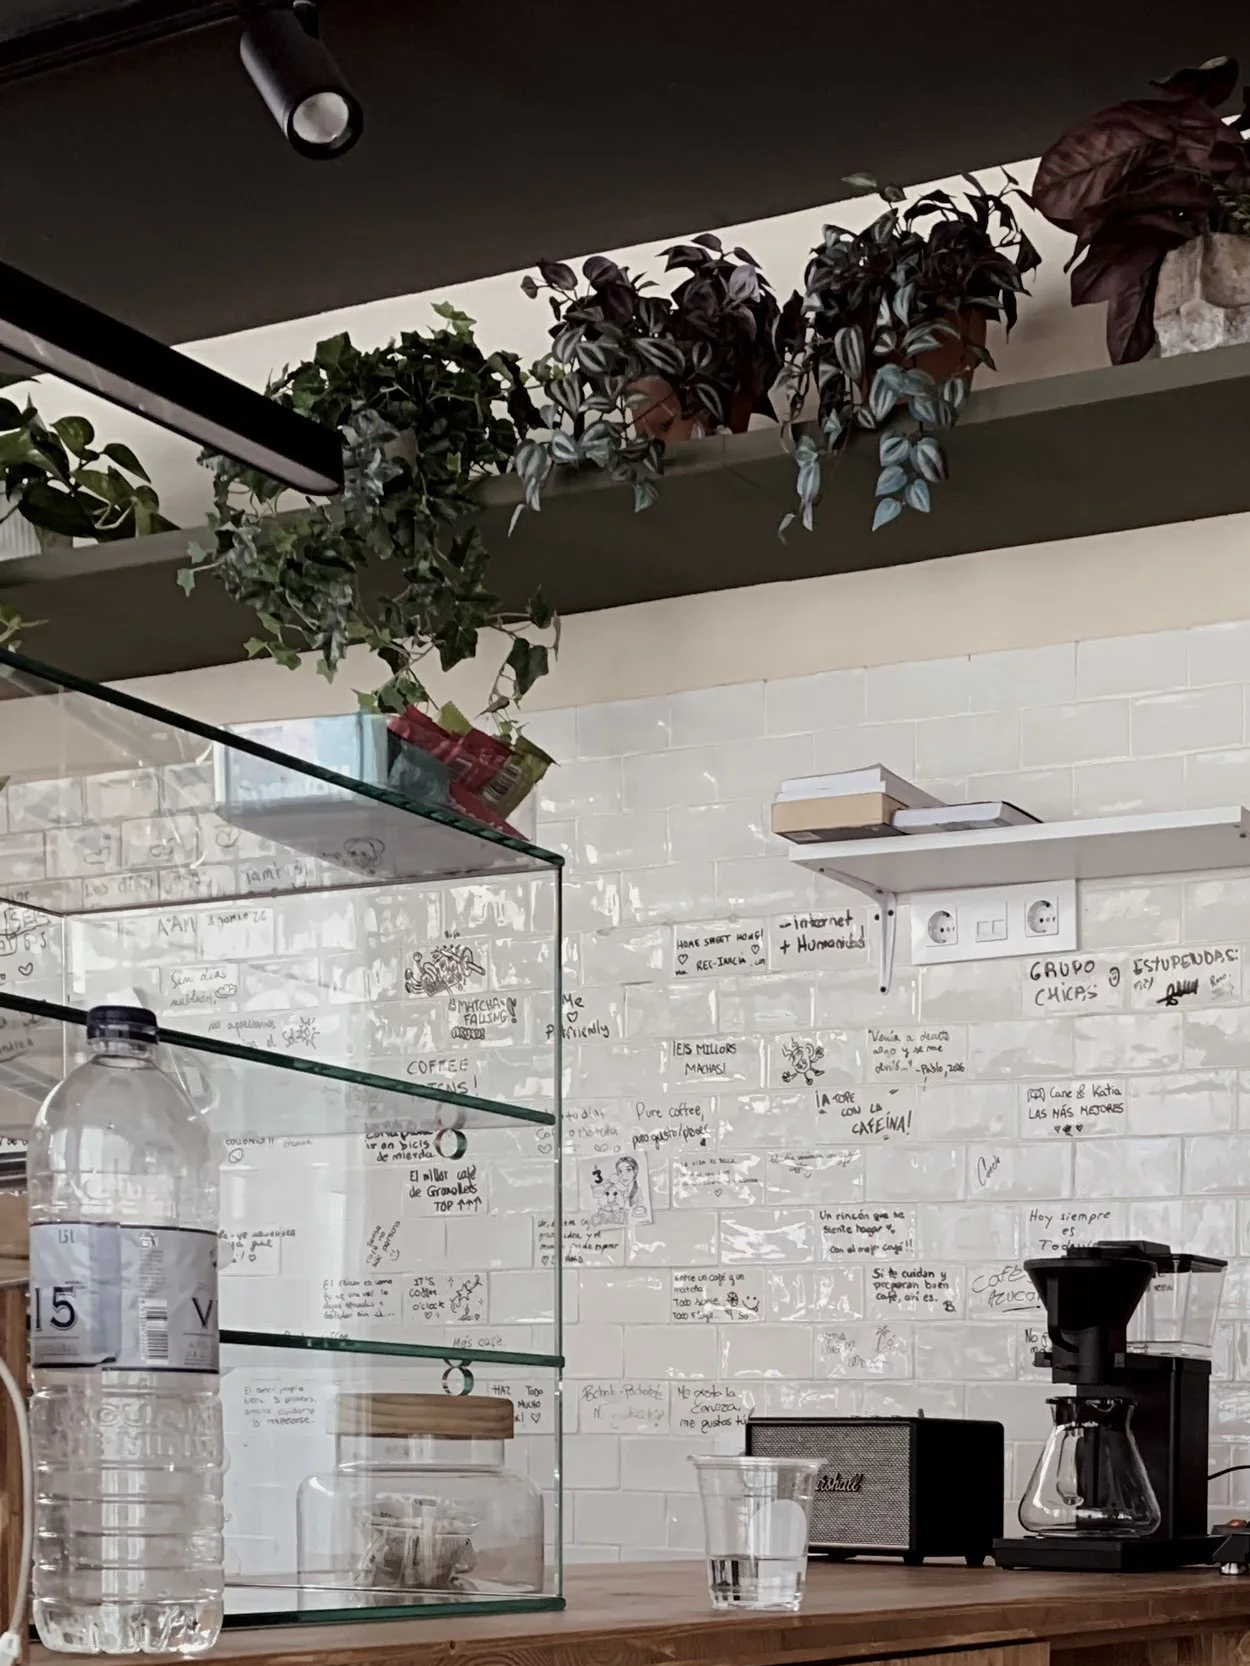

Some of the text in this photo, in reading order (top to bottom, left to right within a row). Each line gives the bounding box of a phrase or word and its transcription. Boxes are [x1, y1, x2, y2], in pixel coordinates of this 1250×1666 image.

[407, 1057, 469, 1076] COFFEE
[841, 1103, 883, 1118] CON LA
[1028, 1106, 1048, 1120] LAS
[1080, 1102, 1125, 1117] MEJORES
[434, 1200, 454, 1212] TOP
[1029, 1209, 1111, 1229] Hoy siempre
[1061, 1226, 1075, 1237] es
[872, 1267, 885, 1279] Si
[901, 1268, 936, 1280] cuidan
[940, 1269, 948, 1282] y
[725, 1386, 736, 1398] la
[679, 1418, 696, 1428] me
